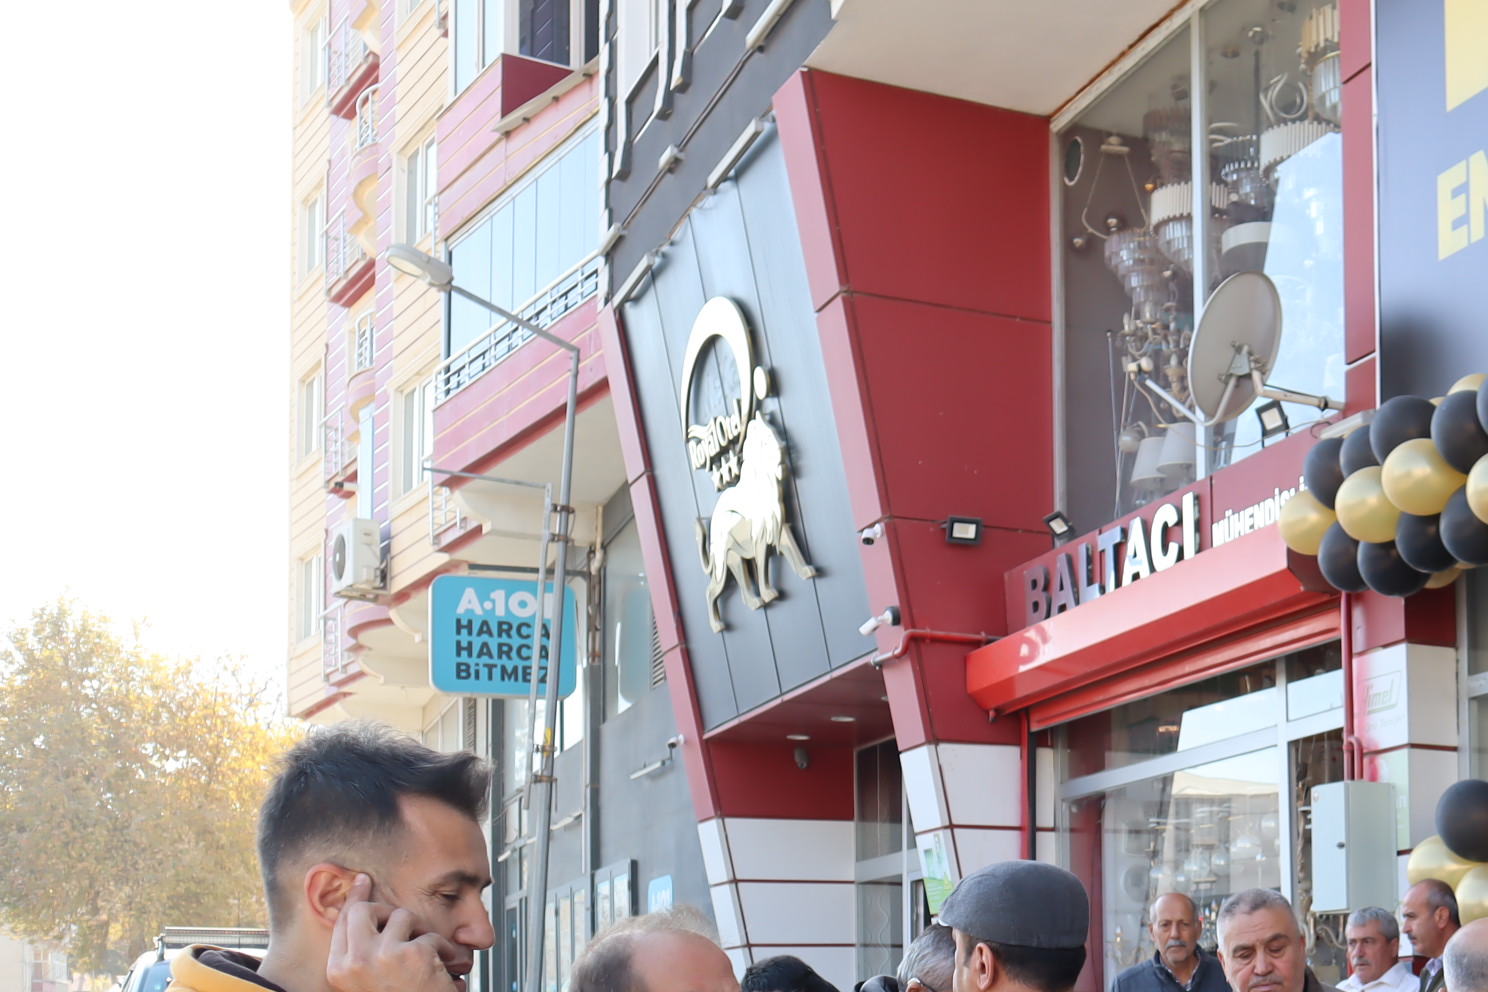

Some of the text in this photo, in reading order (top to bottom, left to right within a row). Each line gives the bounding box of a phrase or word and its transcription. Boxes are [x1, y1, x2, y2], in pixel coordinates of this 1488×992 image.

[1023, 491, 1200, 629] BALTACI
[455, 618, 550, 640] HARCA
[455, 640, 549, 661] HARCA
